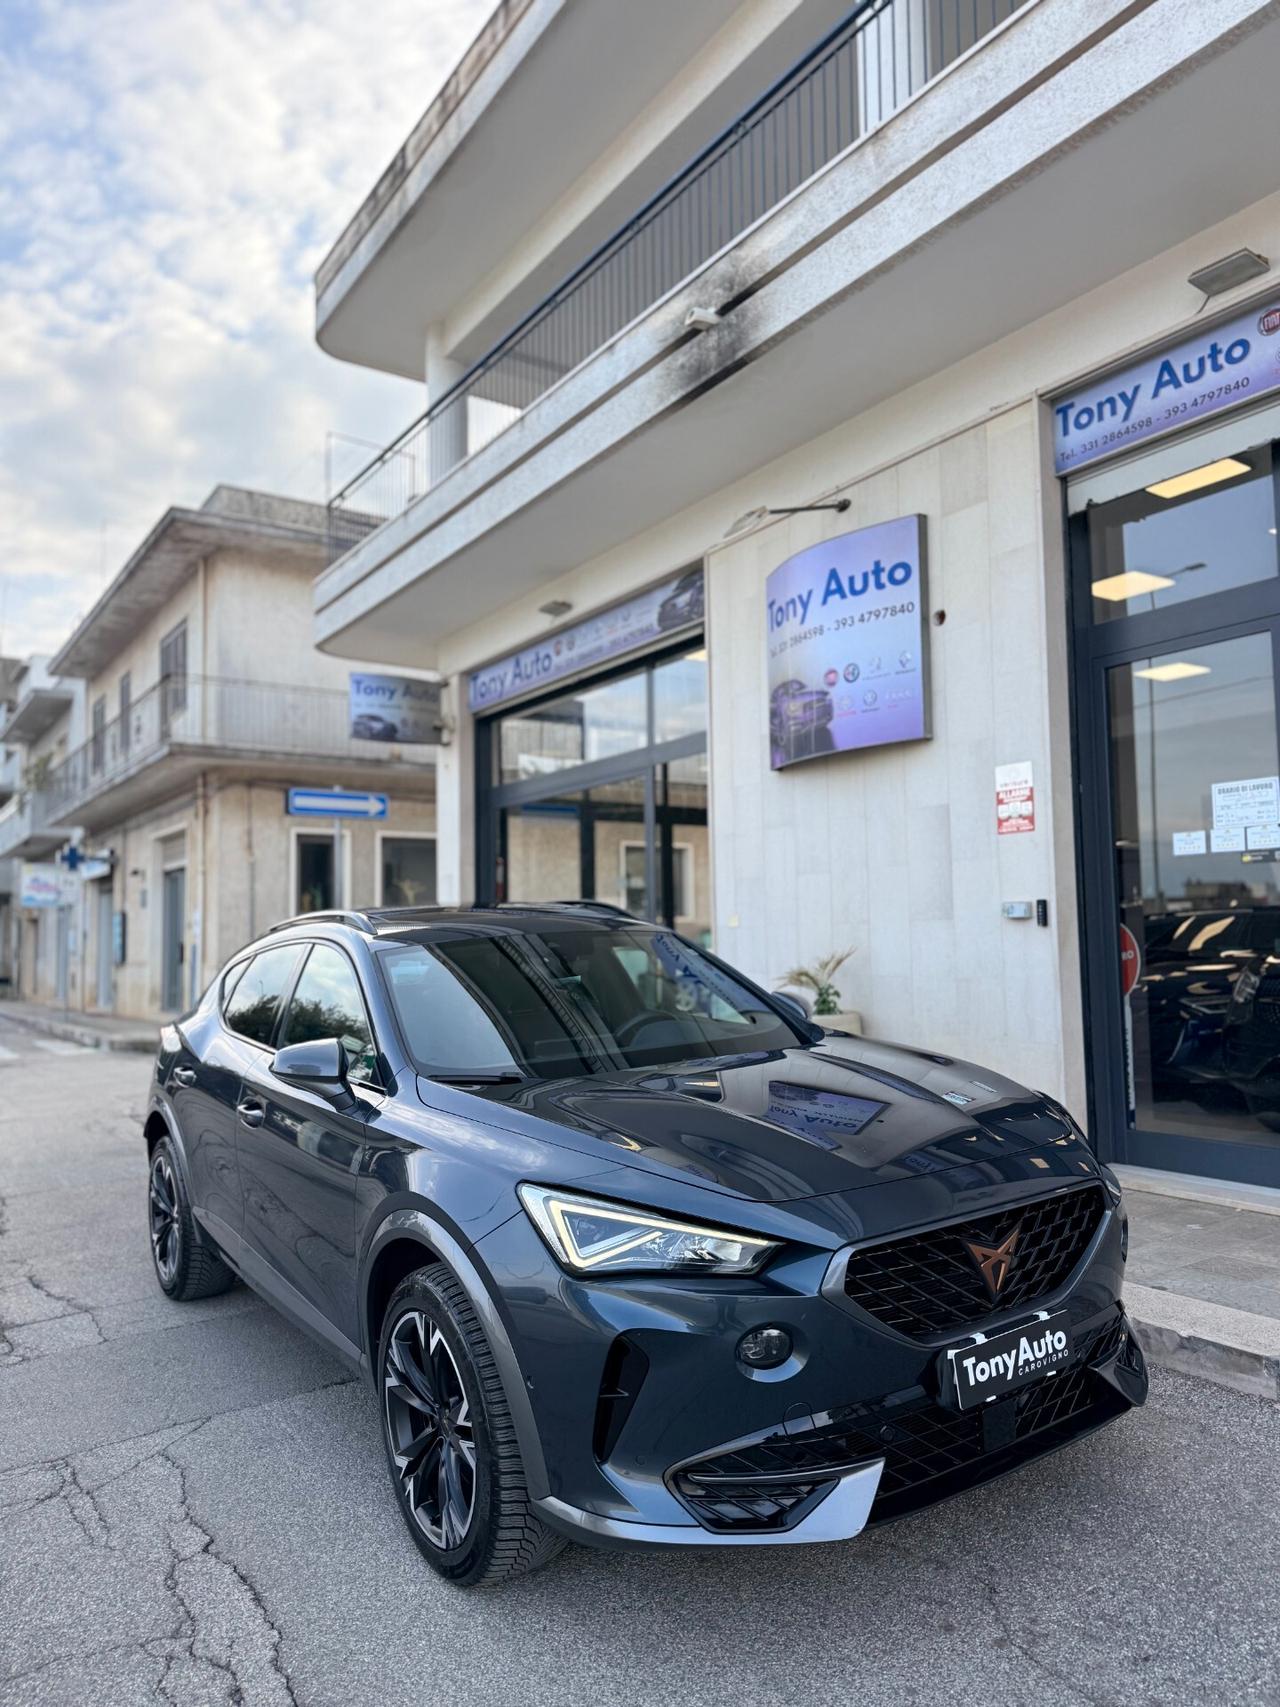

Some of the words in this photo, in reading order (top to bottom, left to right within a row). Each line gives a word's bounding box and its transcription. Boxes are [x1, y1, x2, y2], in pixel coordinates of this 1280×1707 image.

[1056, 383, 1141, 437] Tony
[1151, 338, 1250, 399] Auto
[1080, 439, 1098, 453] 331
[1102, 417, 1153, 446] 2864598
[1164, 403, 1188, 420] 393
[1191, 377, 1250, 407] 4797840
[768, 588, 813, 633] Tony
[821, 560, 912, 607] Auto
[834, 616, 855, 632] 393
[858, 601, 915, 624] 4797840
[353, 680, 397, 700] Tony
[470, 670, 508, 699] Tony
[510, 652, 552, 680] Auto
[962, 1330, 1067, 1386] TonyAuto
[1018, 1349, 1069, 1376] CAROVIGNO
